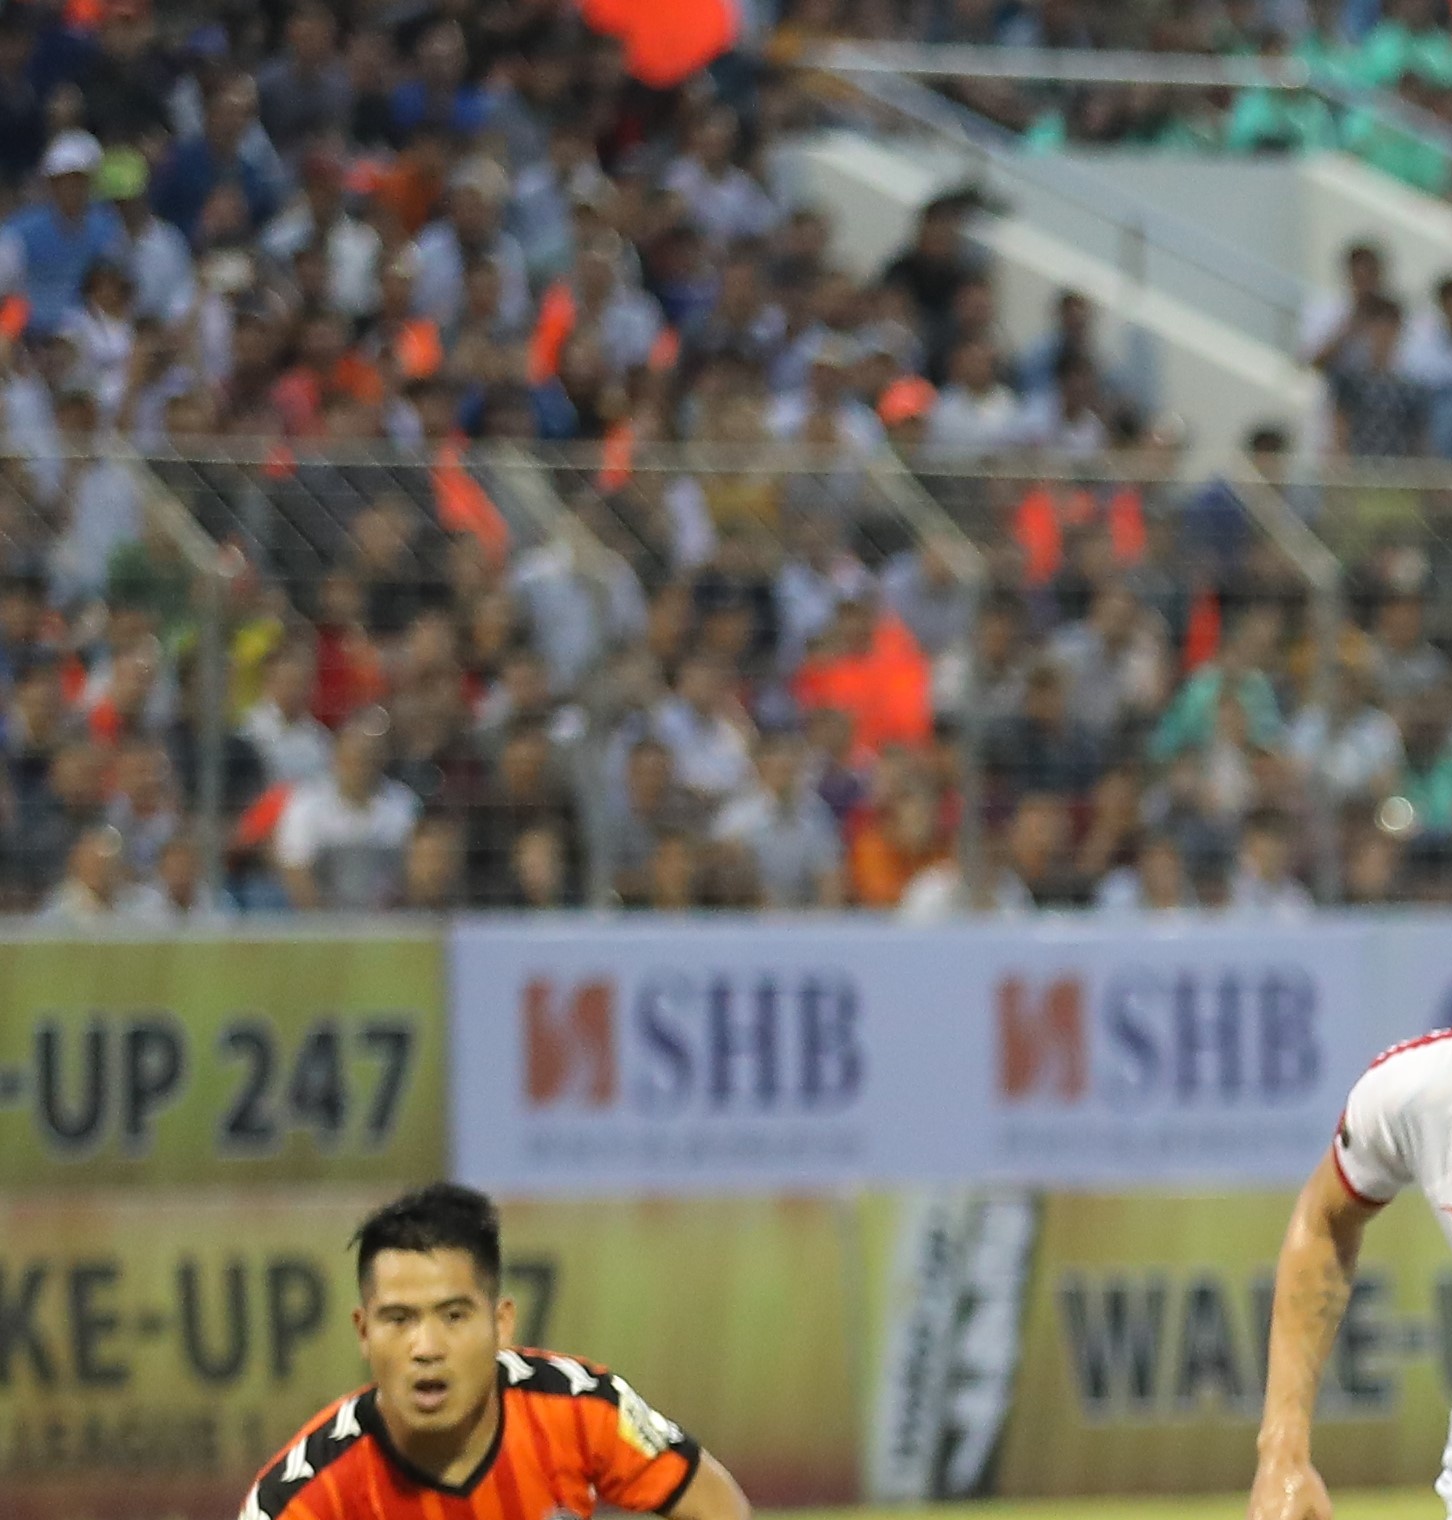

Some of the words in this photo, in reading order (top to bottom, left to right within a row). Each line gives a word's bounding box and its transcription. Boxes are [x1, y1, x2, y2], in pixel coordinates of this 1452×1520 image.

[216, 1014, 416, 1158] 247
[634, 970, 868, 1114] SHB
[1107, 966, 1320, 1108] SHB
